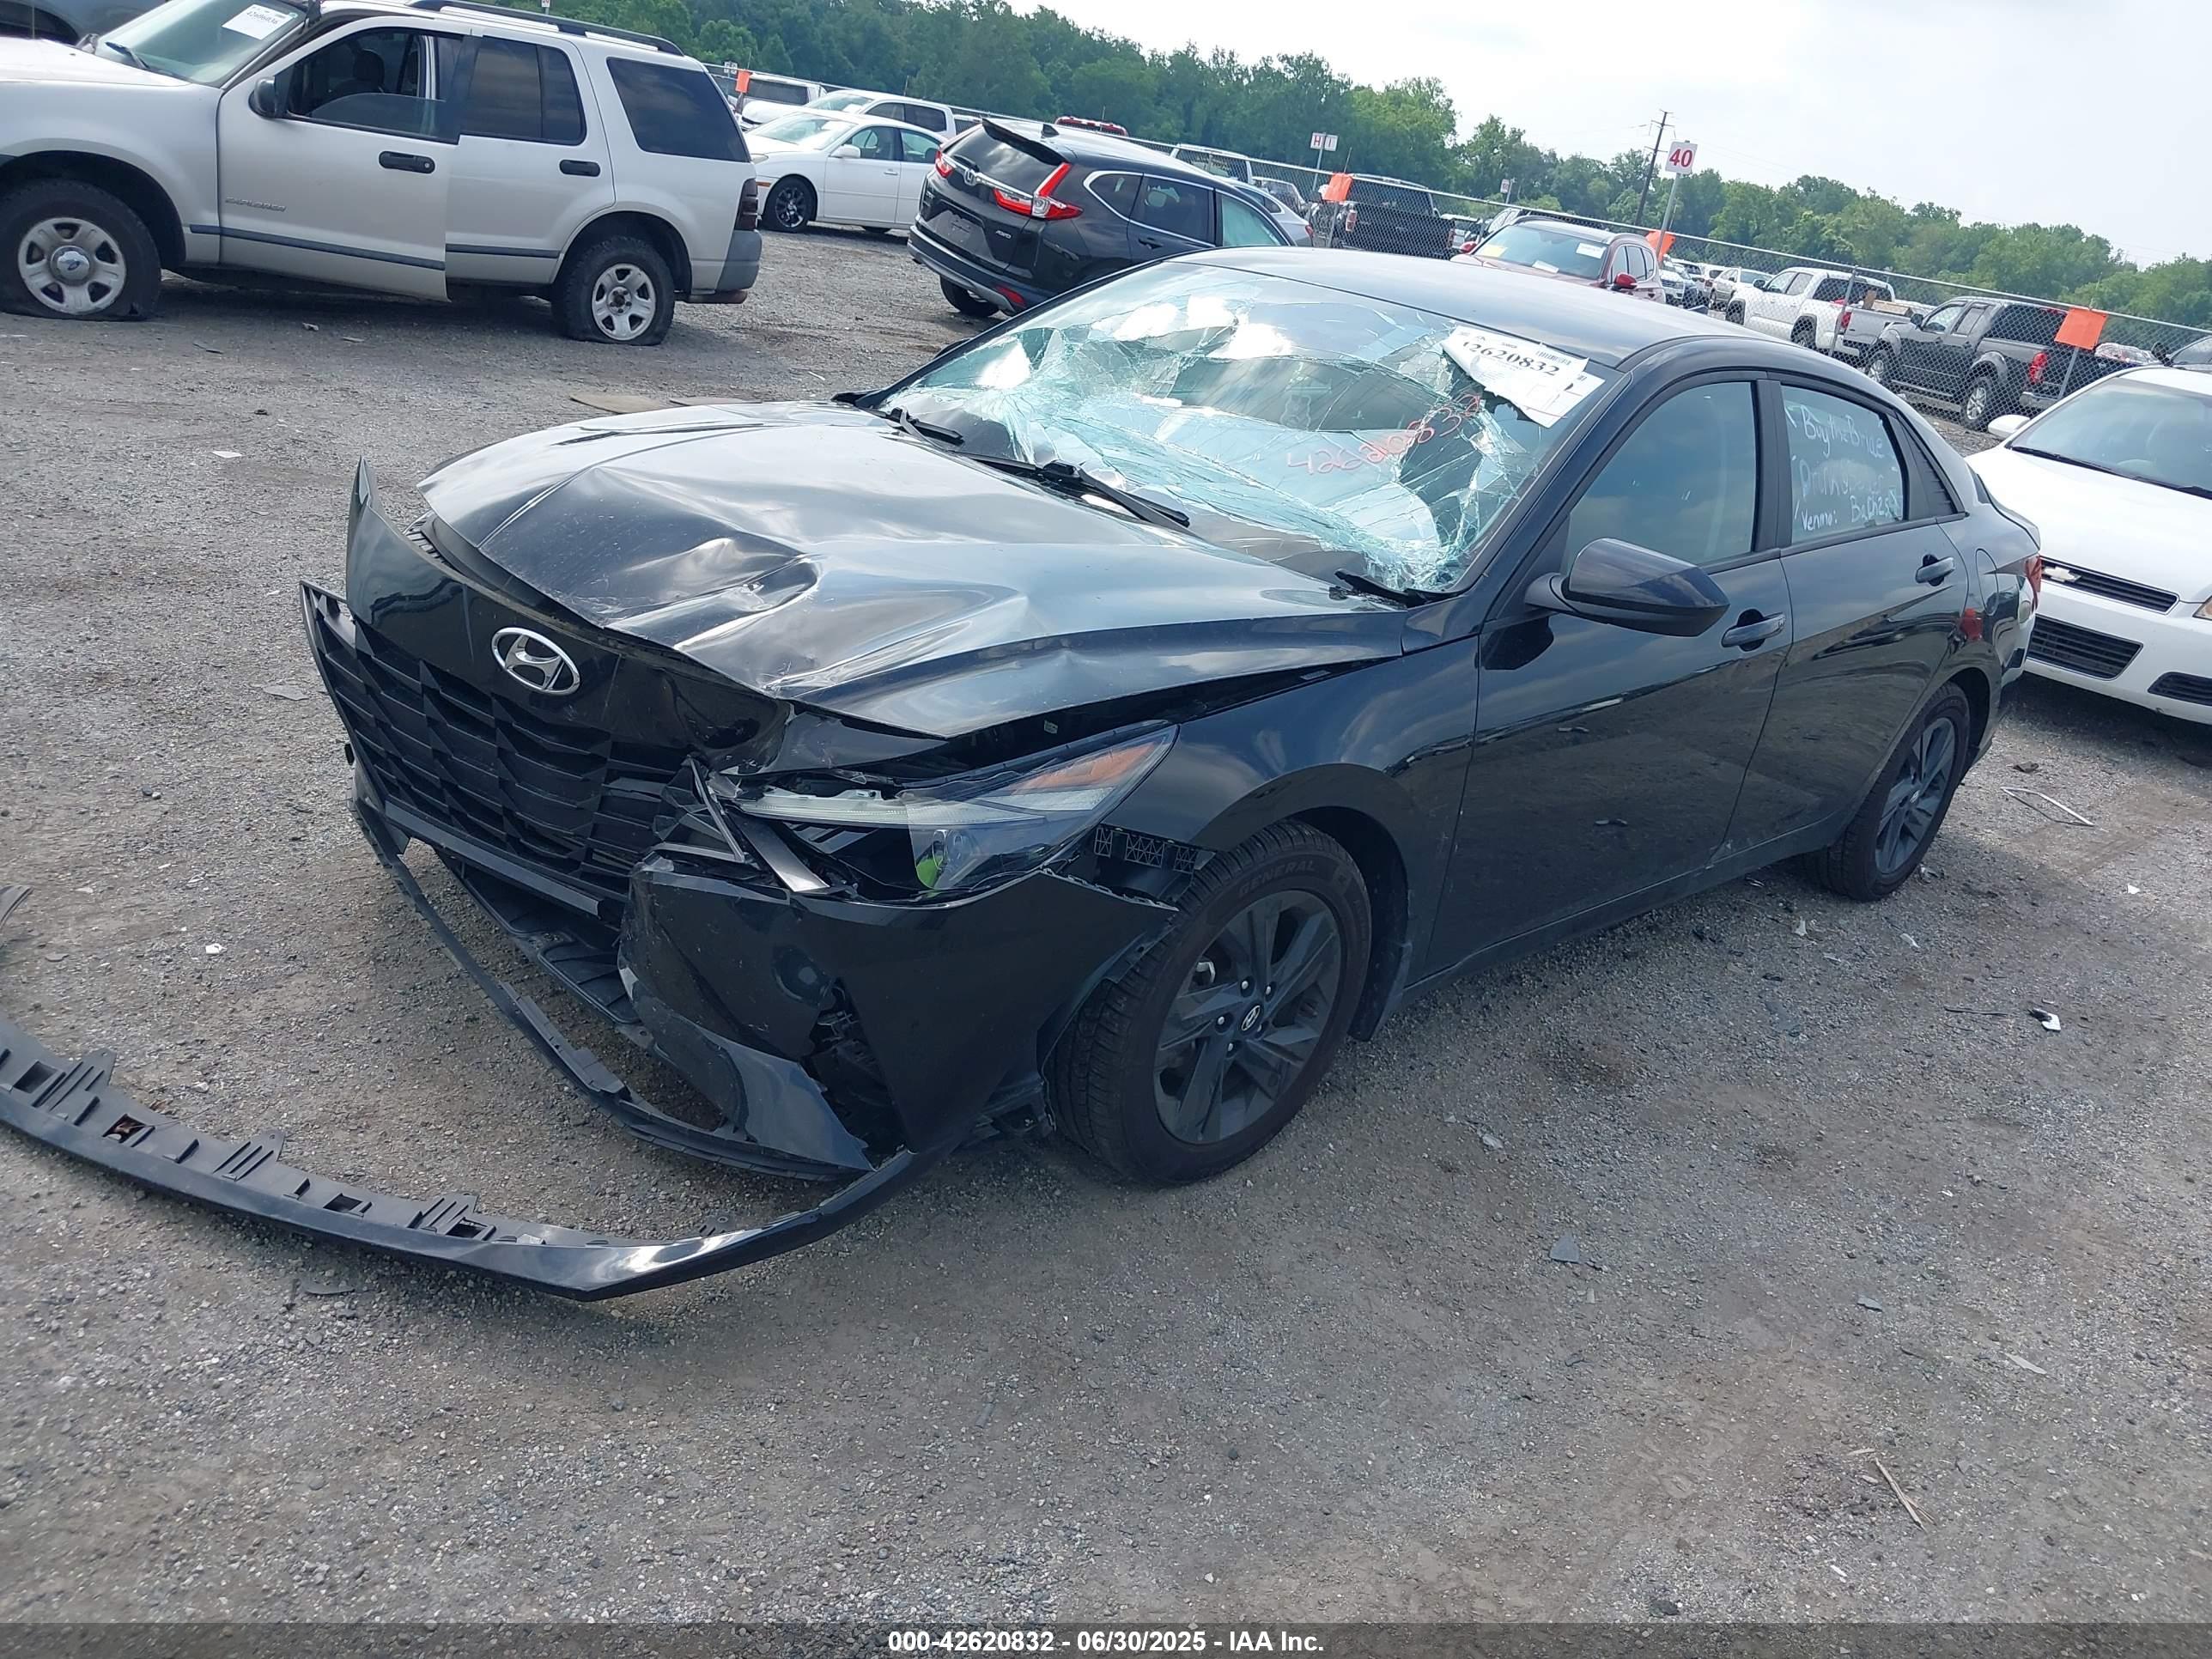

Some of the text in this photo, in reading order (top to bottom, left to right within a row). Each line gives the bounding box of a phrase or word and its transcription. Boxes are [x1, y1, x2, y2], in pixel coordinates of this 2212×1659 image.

[1314, 135, 1322, 147] H
[1669, 149, 1692, 167] 40
[224, 196, 287, 213] EXPLORER
[1801, 509, 1838, 531] Venmo:
[1239, 860, 1316, 895] GENERAL
